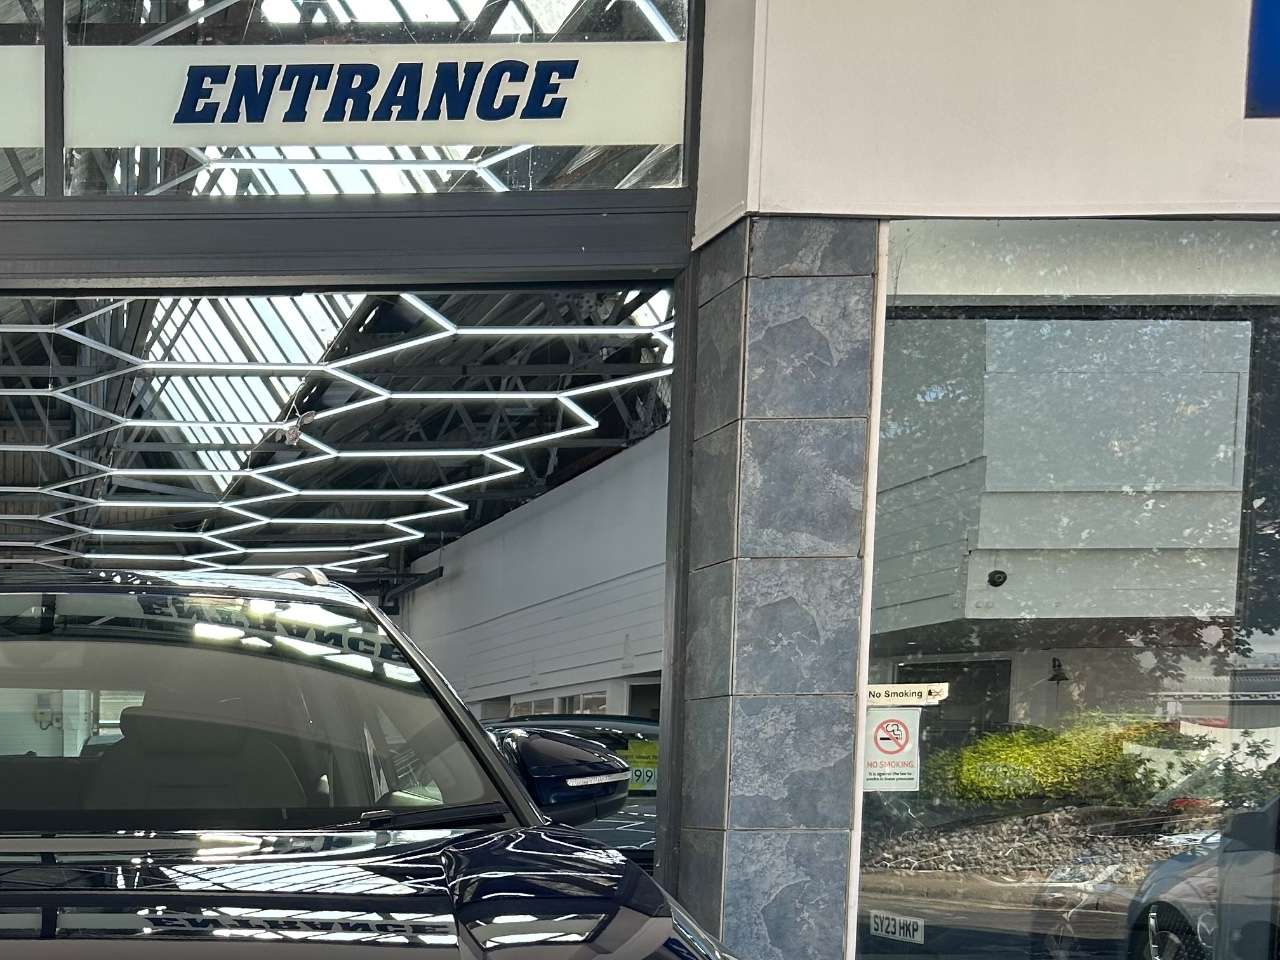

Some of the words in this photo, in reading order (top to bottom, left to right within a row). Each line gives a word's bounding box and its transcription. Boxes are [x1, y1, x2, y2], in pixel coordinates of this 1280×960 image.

[173, 59, 579, 124] ENTRANCE
[868, 690, 881, 698] No
[884, 689, 923, 698] Smoking
[866, 761, 878, 769] NO
[879, 761, 914, 769] SMOKING
[873, 914, 897, 935] SY23
[899, 919, 919, 939] HKP
